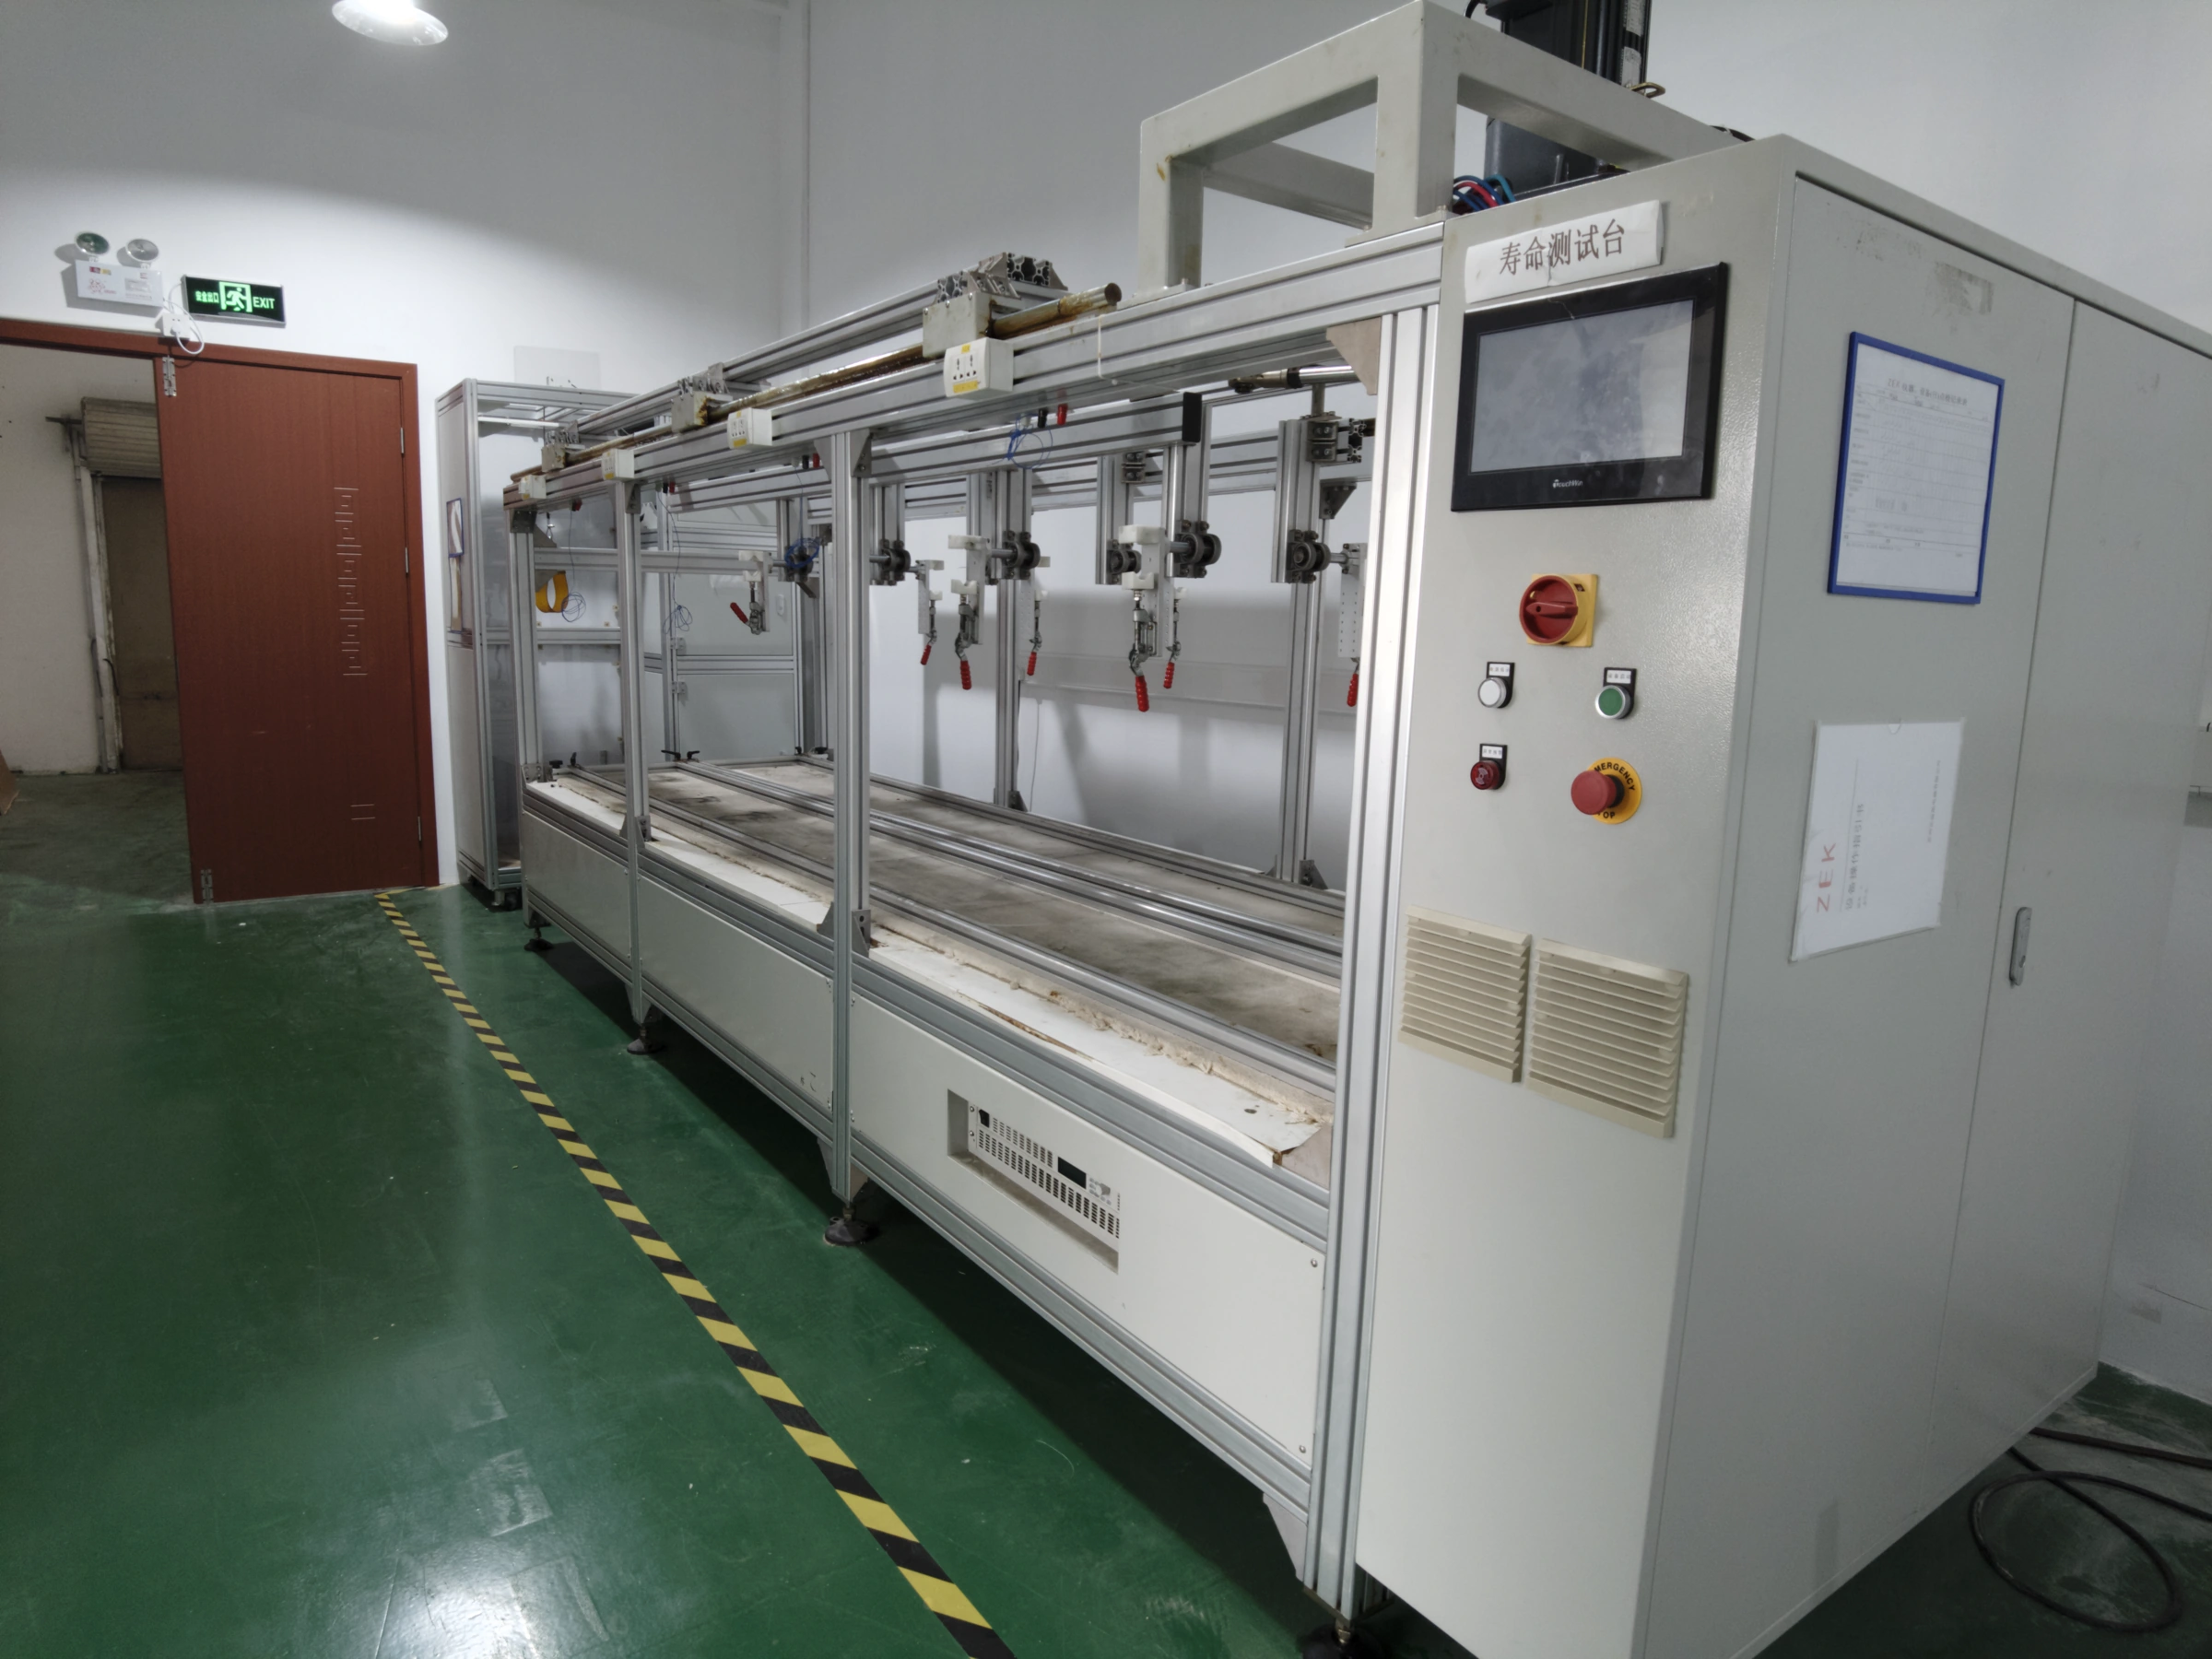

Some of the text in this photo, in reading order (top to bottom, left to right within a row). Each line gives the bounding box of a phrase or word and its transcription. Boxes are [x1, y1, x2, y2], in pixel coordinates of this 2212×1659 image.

[1500, 218, 1625, 275] 寿命测试台
[195, 290, 219, 303] 安全出口
[253, 296, 275, 309] EXIT
[1594, 761, 1636, 792] MERGENCY
[1816, 843, 1836, 912] ZEK
